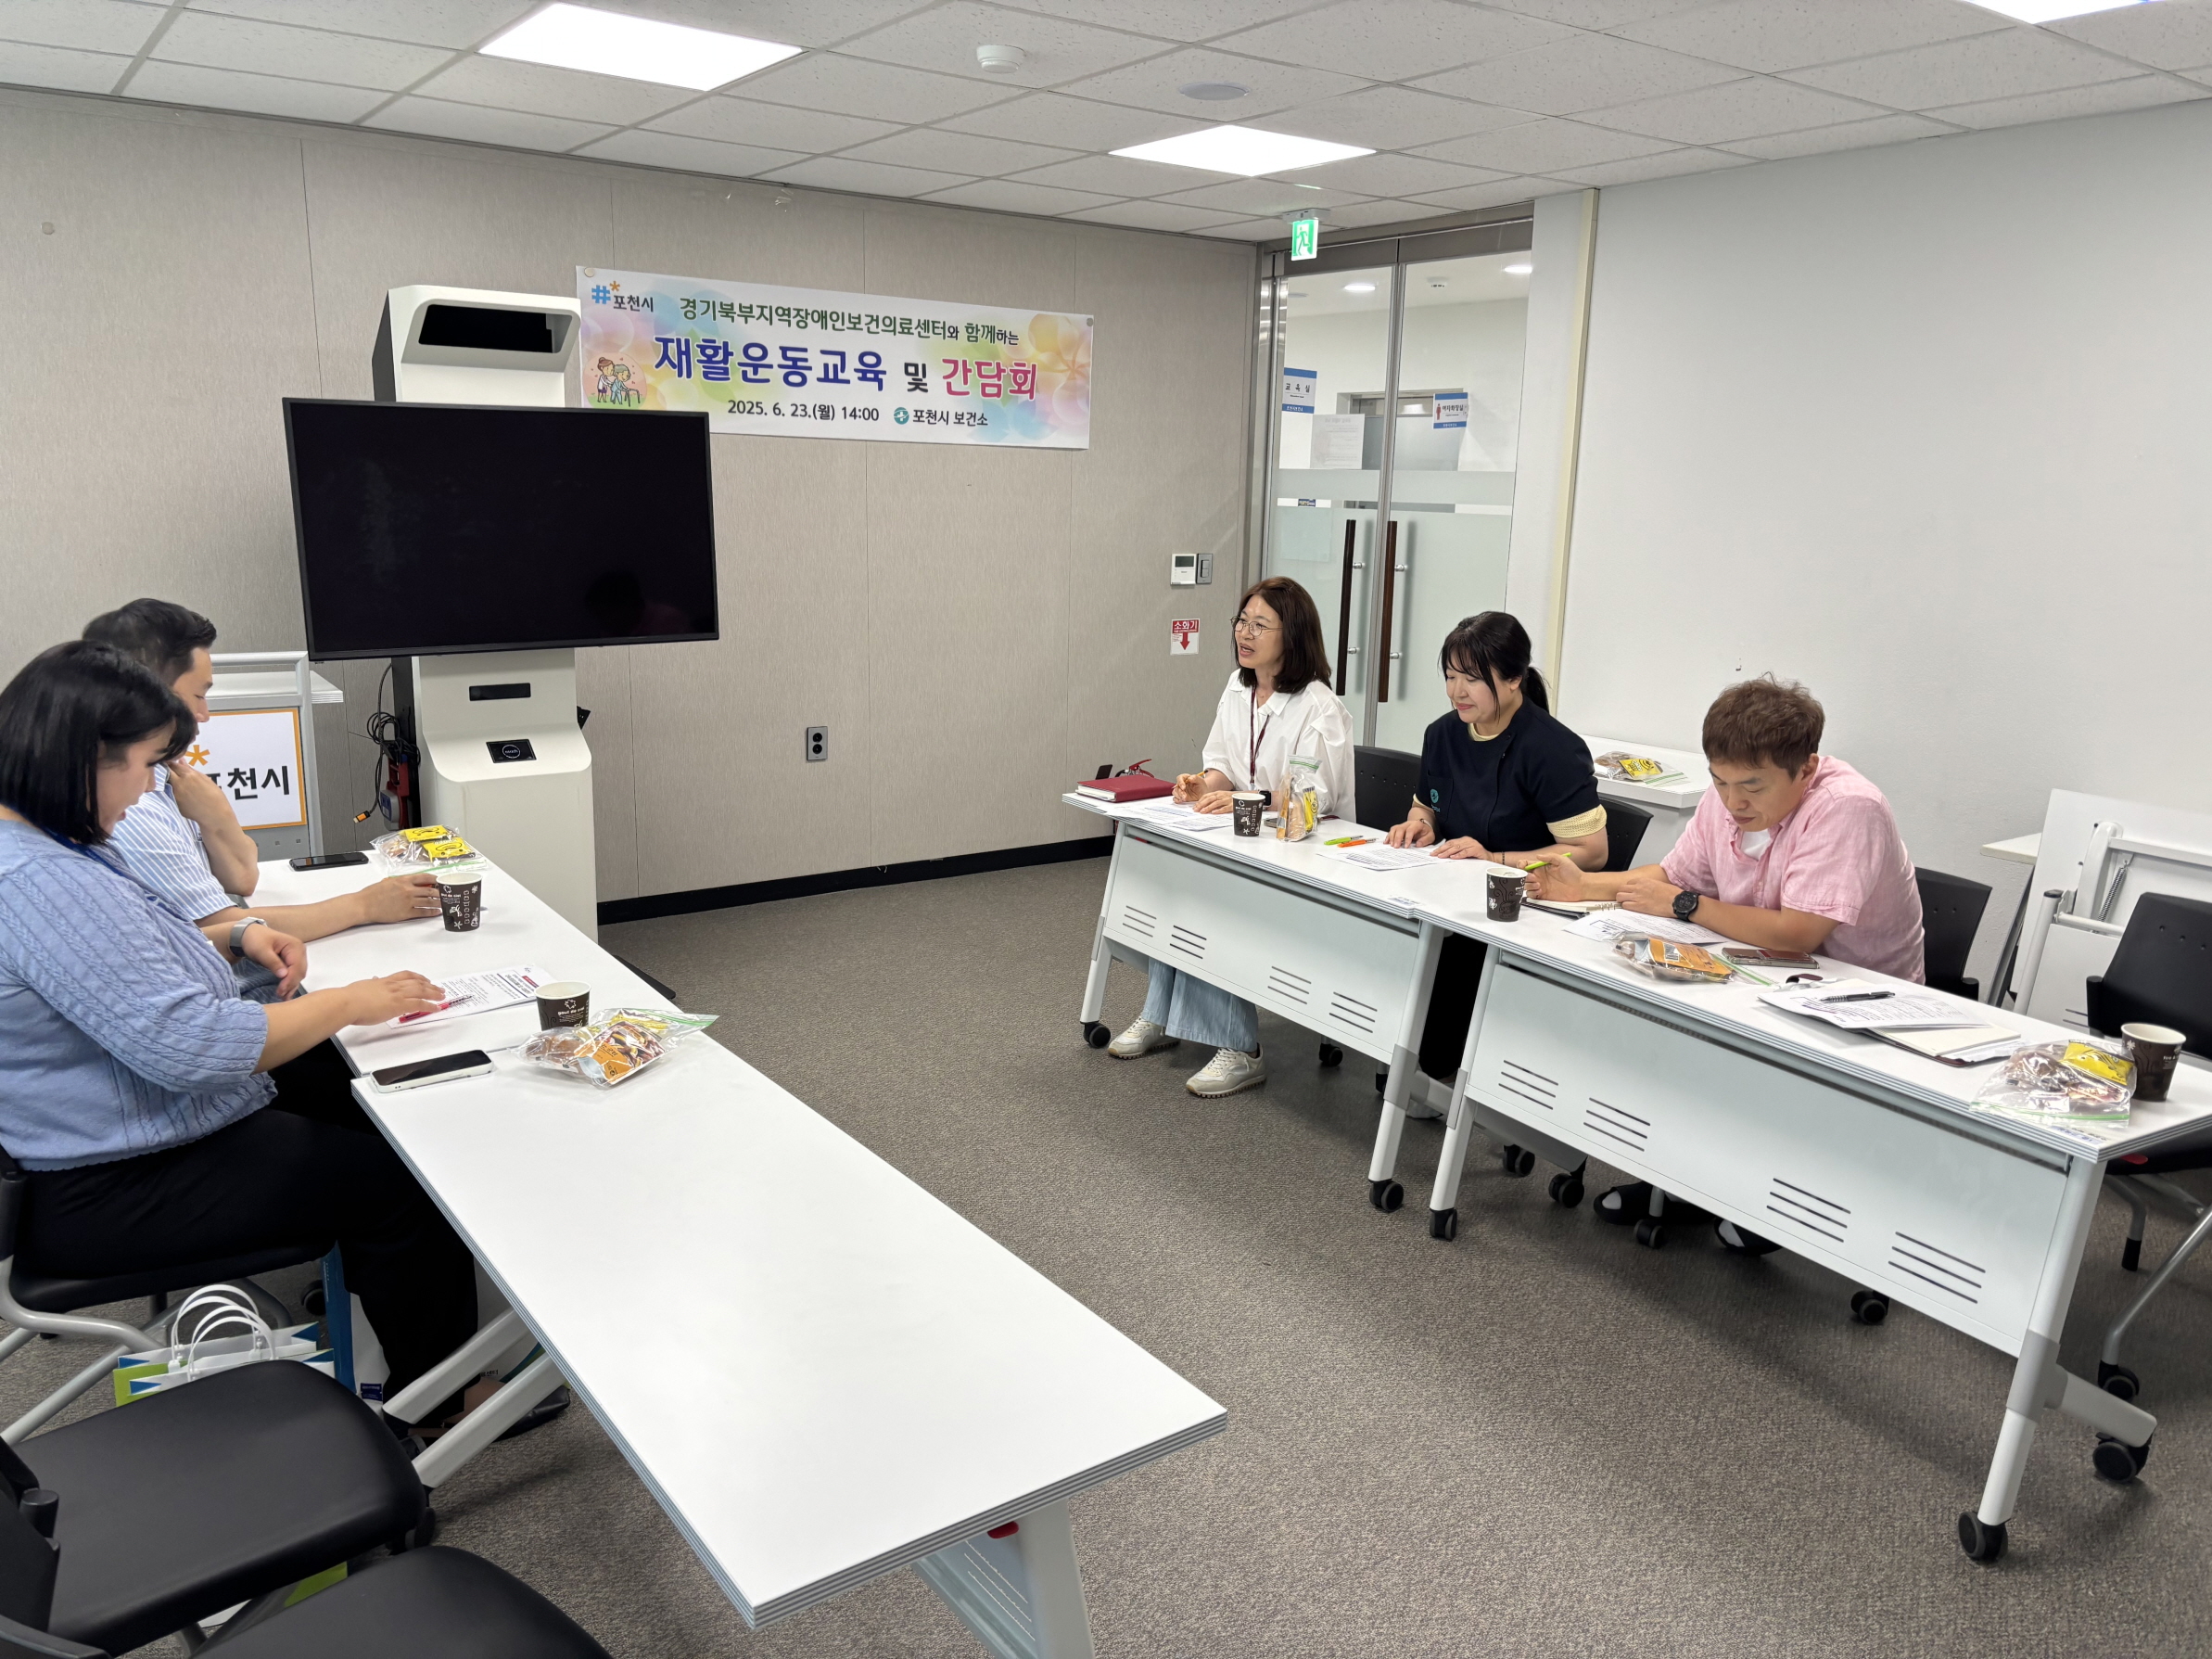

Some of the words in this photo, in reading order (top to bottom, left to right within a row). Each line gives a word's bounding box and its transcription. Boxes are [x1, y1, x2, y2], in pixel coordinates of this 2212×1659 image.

[614, 295, 654, 313] 포천시
[680, 298, 960, 340] 경기북부지역장애인보건의료센터와
[964, 323, 1020, 345] 함께하는
[655, 337, 887, 391] 재활운동교육
[904, 363, 929, 393] 및
[942, 358, 1036, 401] 간담회
[727, 400, 768, 416] 2025.
[772, 402, 785, 417] 6.
[841, 406, 880, 421] 14:00
[912, 409, 949, 426] 포천시
[953, 411, 989, 427] 보건소
[1174, 620, 1198, 630] 소화기
